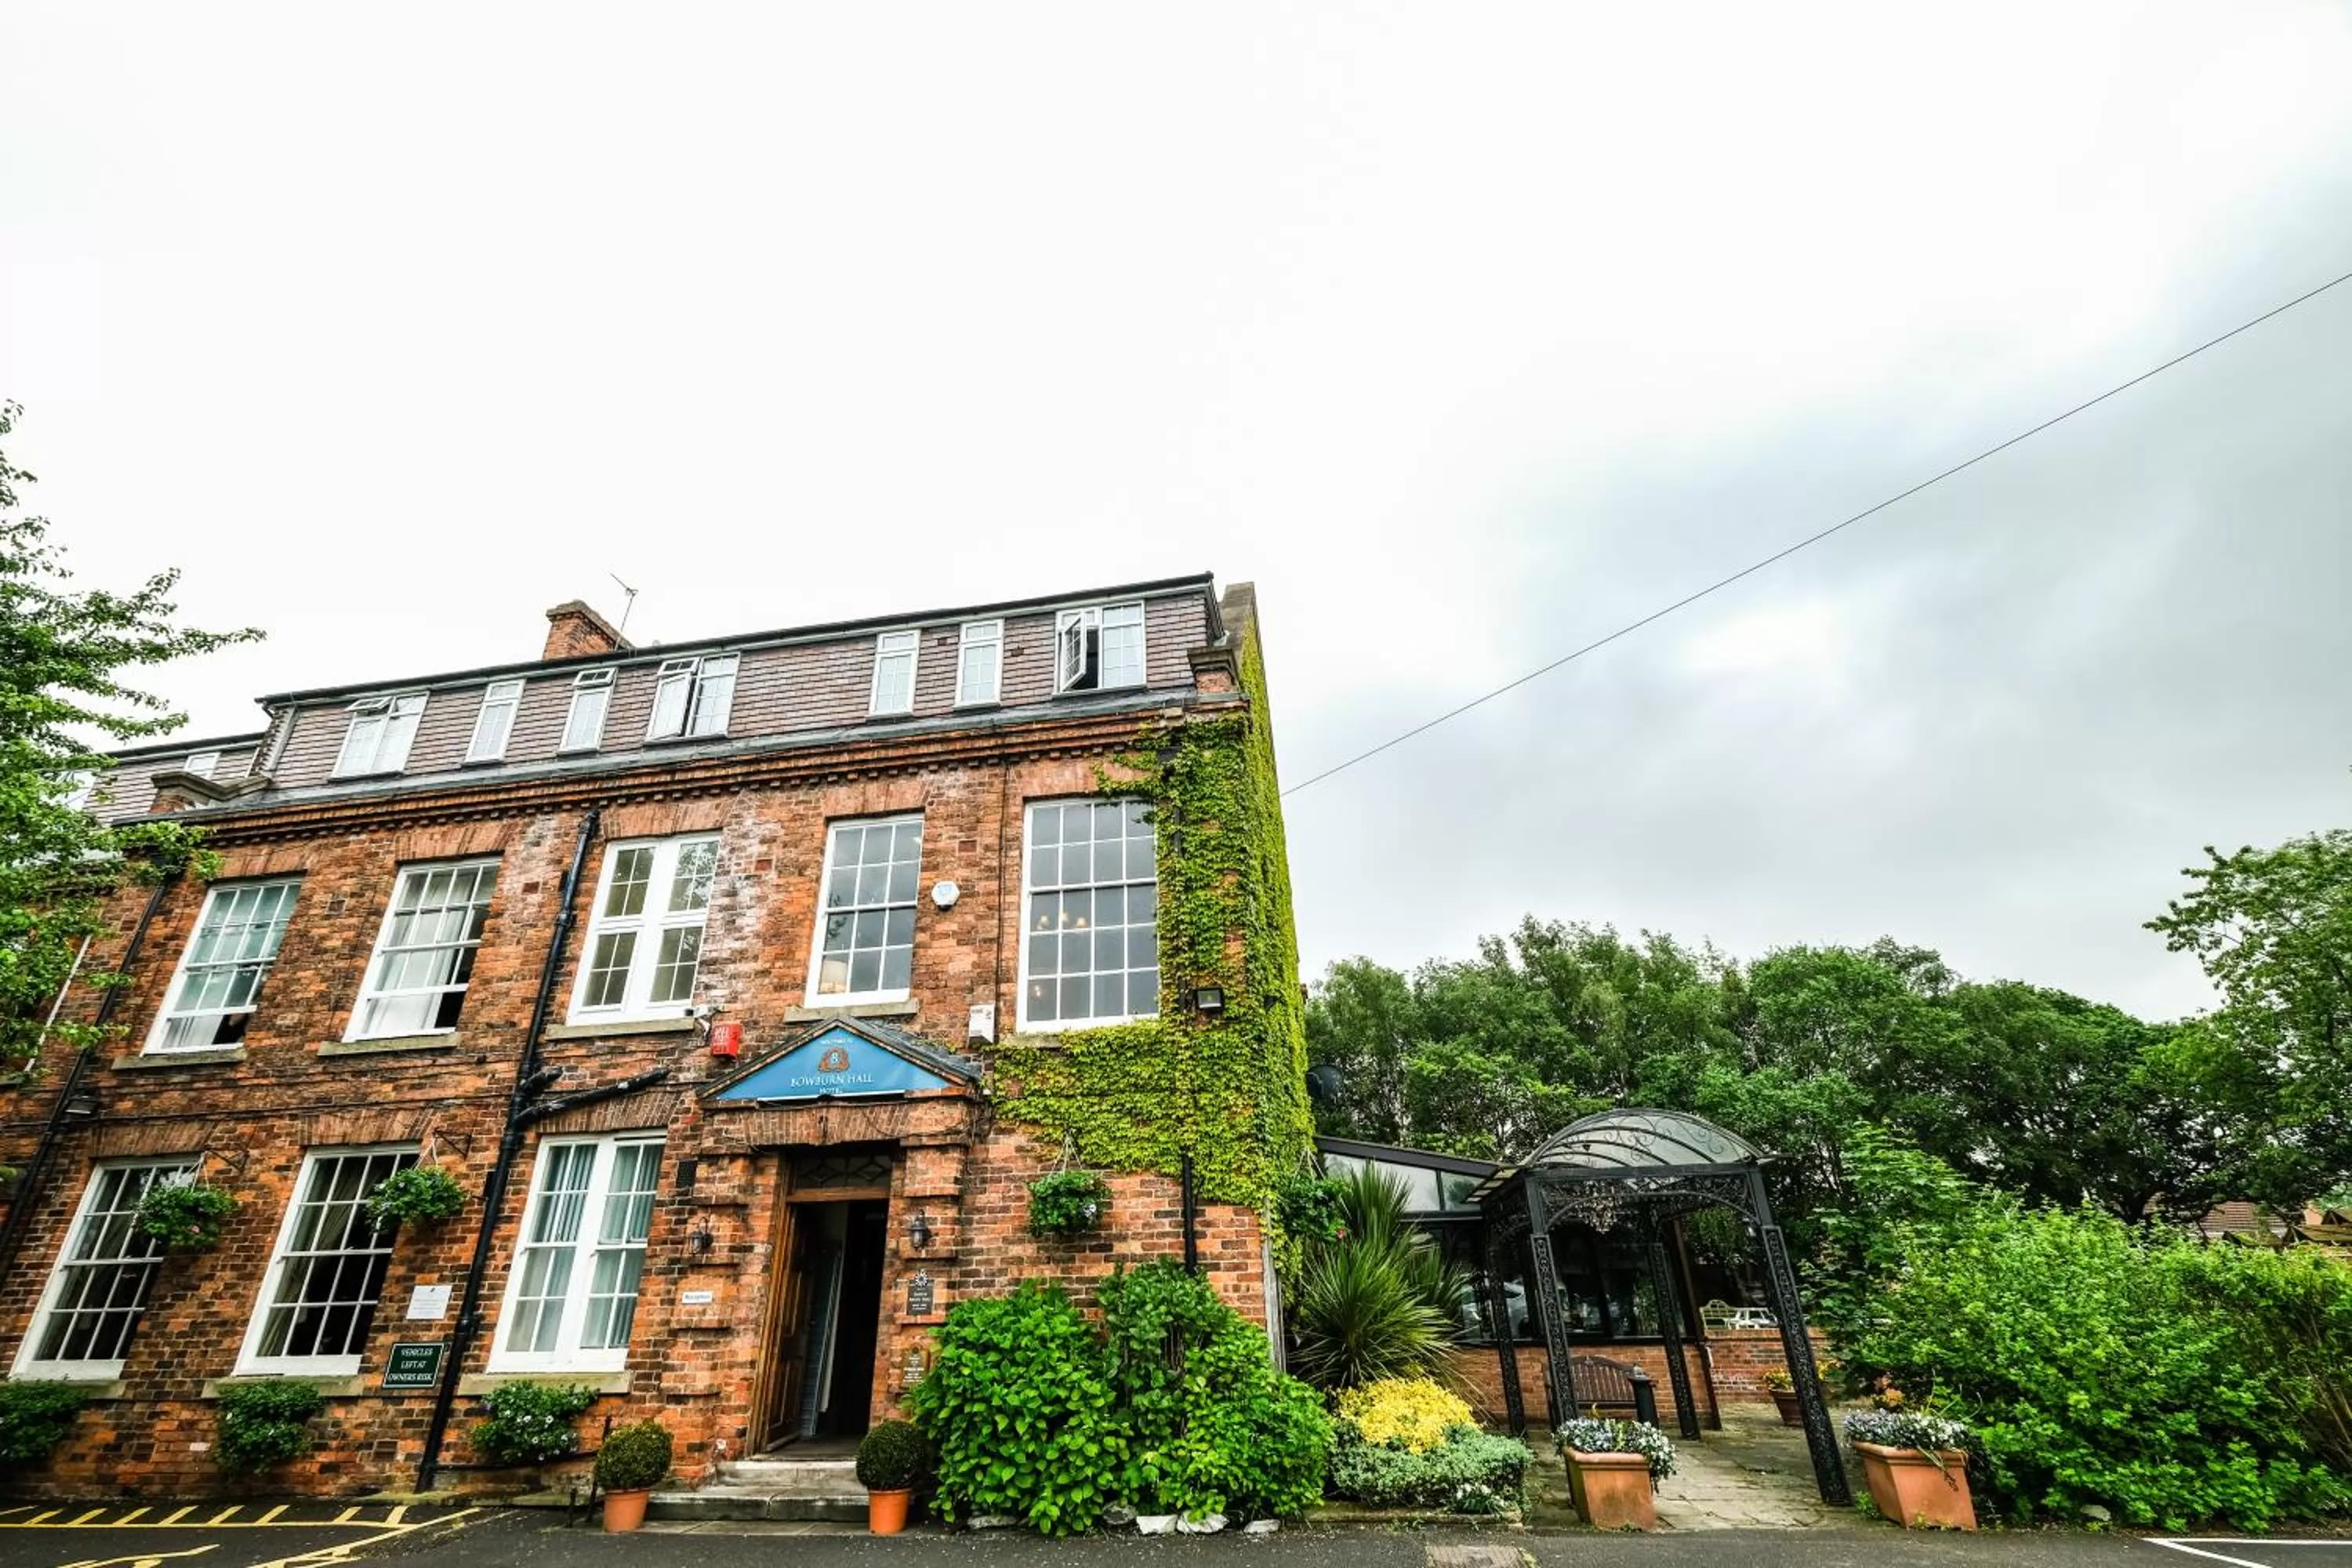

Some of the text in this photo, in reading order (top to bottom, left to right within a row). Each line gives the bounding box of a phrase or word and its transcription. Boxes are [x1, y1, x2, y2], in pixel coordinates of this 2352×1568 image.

[848, 1072, 874, 1083] HALL
[401, 1348, 434, 1356] VEHICLES
[401, 1360, 418, 1369] LEFT
